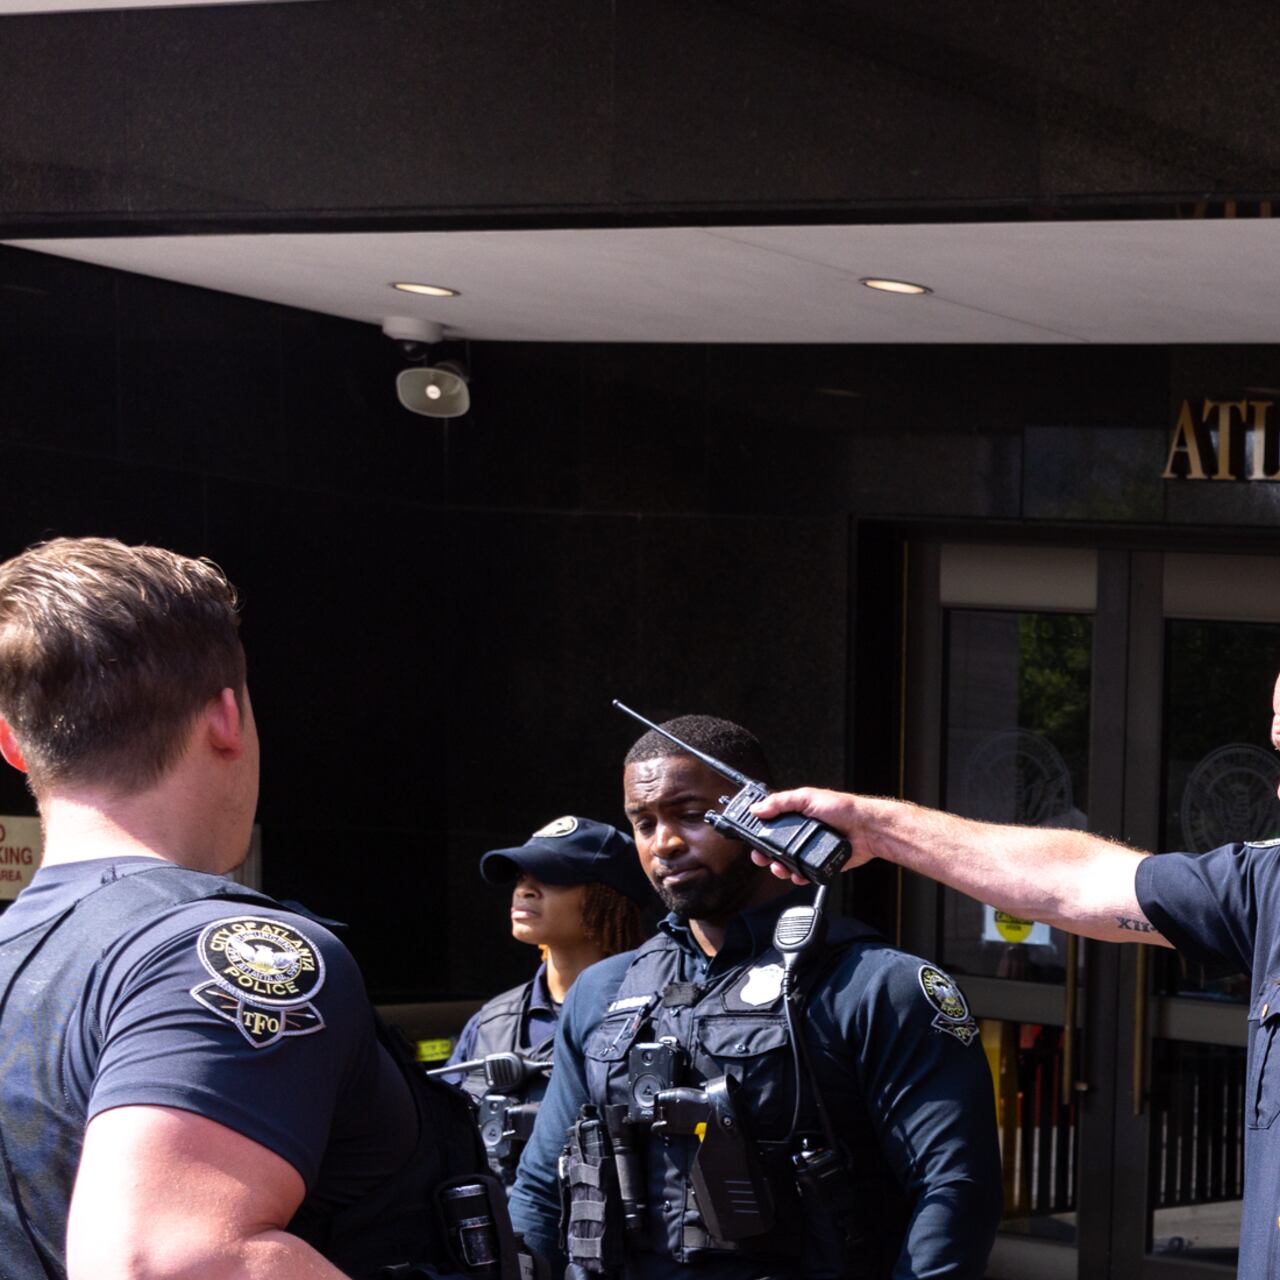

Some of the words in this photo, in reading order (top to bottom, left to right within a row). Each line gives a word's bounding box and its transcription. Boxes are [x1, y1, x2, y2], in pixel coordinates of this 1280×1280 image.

[0, 869, 22, 881] REA
[210, 928, 230, 952] CITY
[231, 922, 257, 933] OF
[261, 924, 316, 972] ATLANTA
[224, 966, 300, 996] POLICE
[243, 1011, 280, 1035] TFO
